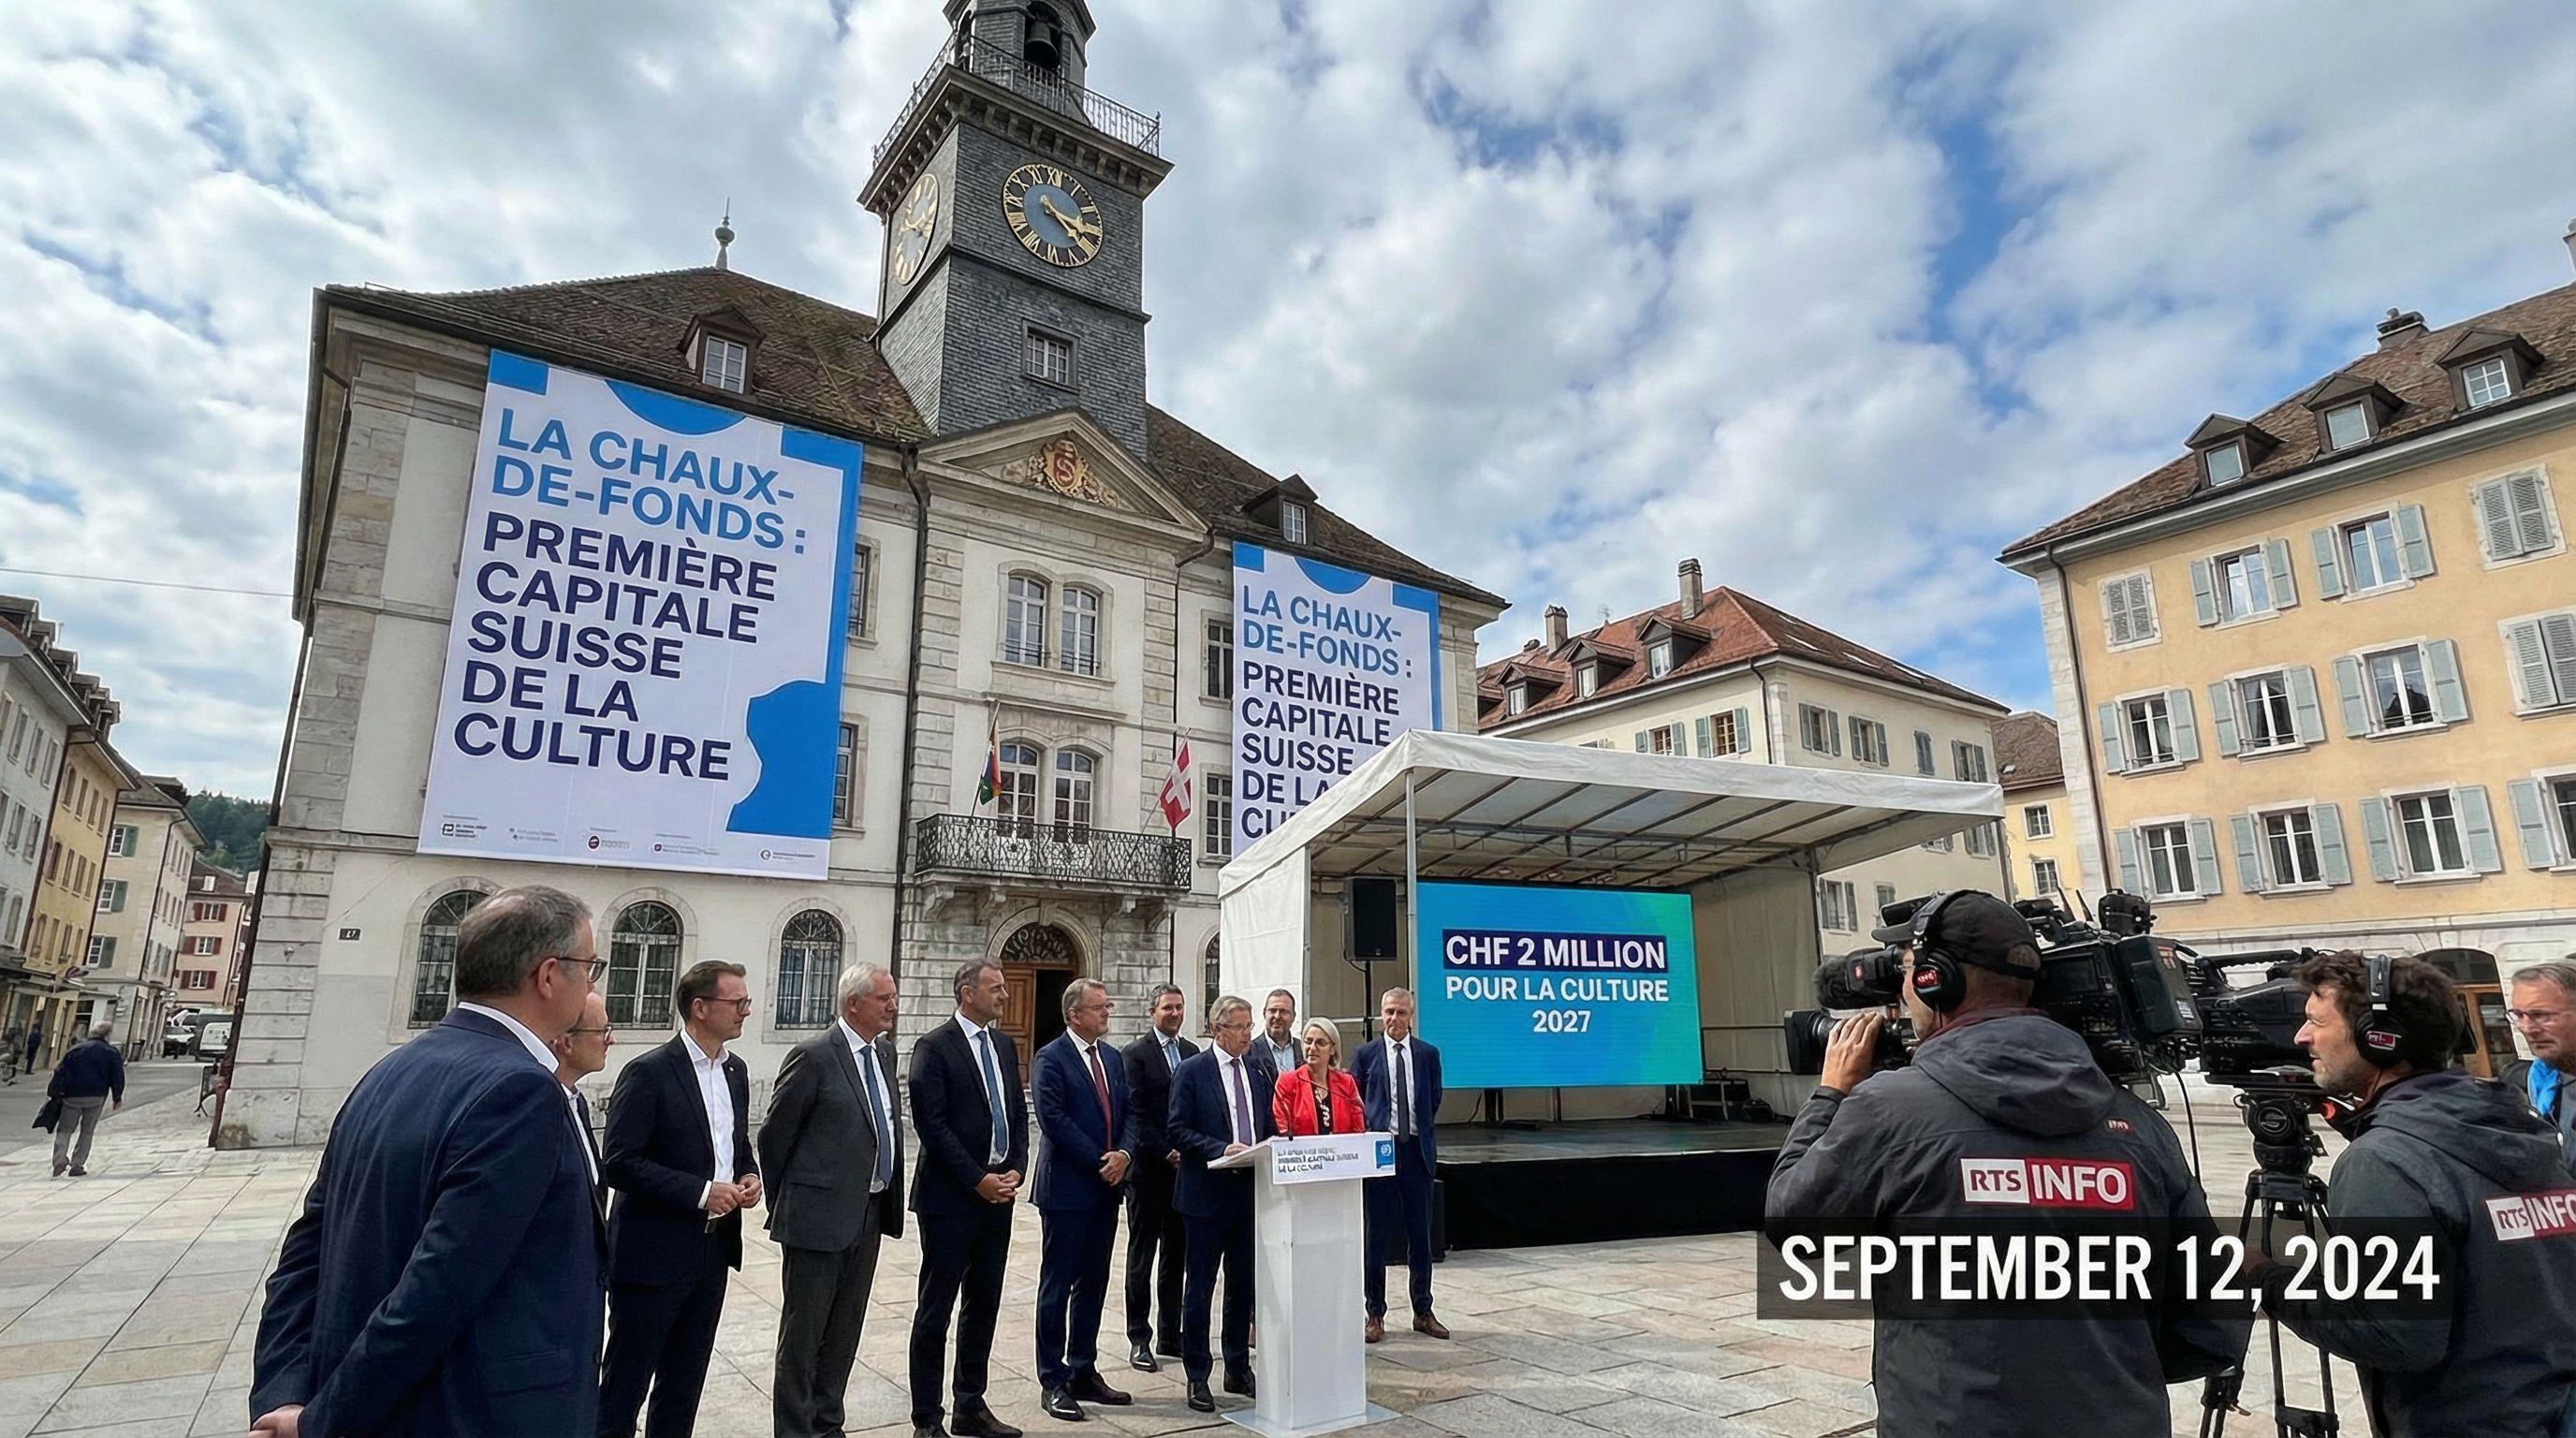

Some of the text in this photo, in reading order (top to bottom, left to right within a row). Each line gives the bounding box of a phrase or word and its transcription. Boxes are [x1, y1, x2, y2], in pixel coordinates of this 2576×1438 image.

[498, 408, 794, 506] LA CHAUX-
[483, 510, 778, 602] PREMIÈRE
[476, 561, 759, 644] CAPITALE
[1243, 585, 1401, 642] LA CHAUX-
[467, 610, 683, 679] SUISSE
[462, 660, 638, 722] DE LA
[1243, 660, 1399, 715] PREMIÈRE
[454, 712, 731, 781] CULTURE
[1242, 697, 1391, 747] CAPITALE
[1241, 732, 1354, 775] SUISSE
[1242, 769, 1284, 804] DE
[1446, 935, 1666, 969] CHF 2 MILLION
[1446, 976, 1669, 1002] POUR LA CULTURE
[1532, 1009, 1591, 1033] 2027
[1969, 1165, 2129, 1205] RTS INFO
[2496, 1207, 2529, 1229] RTS
